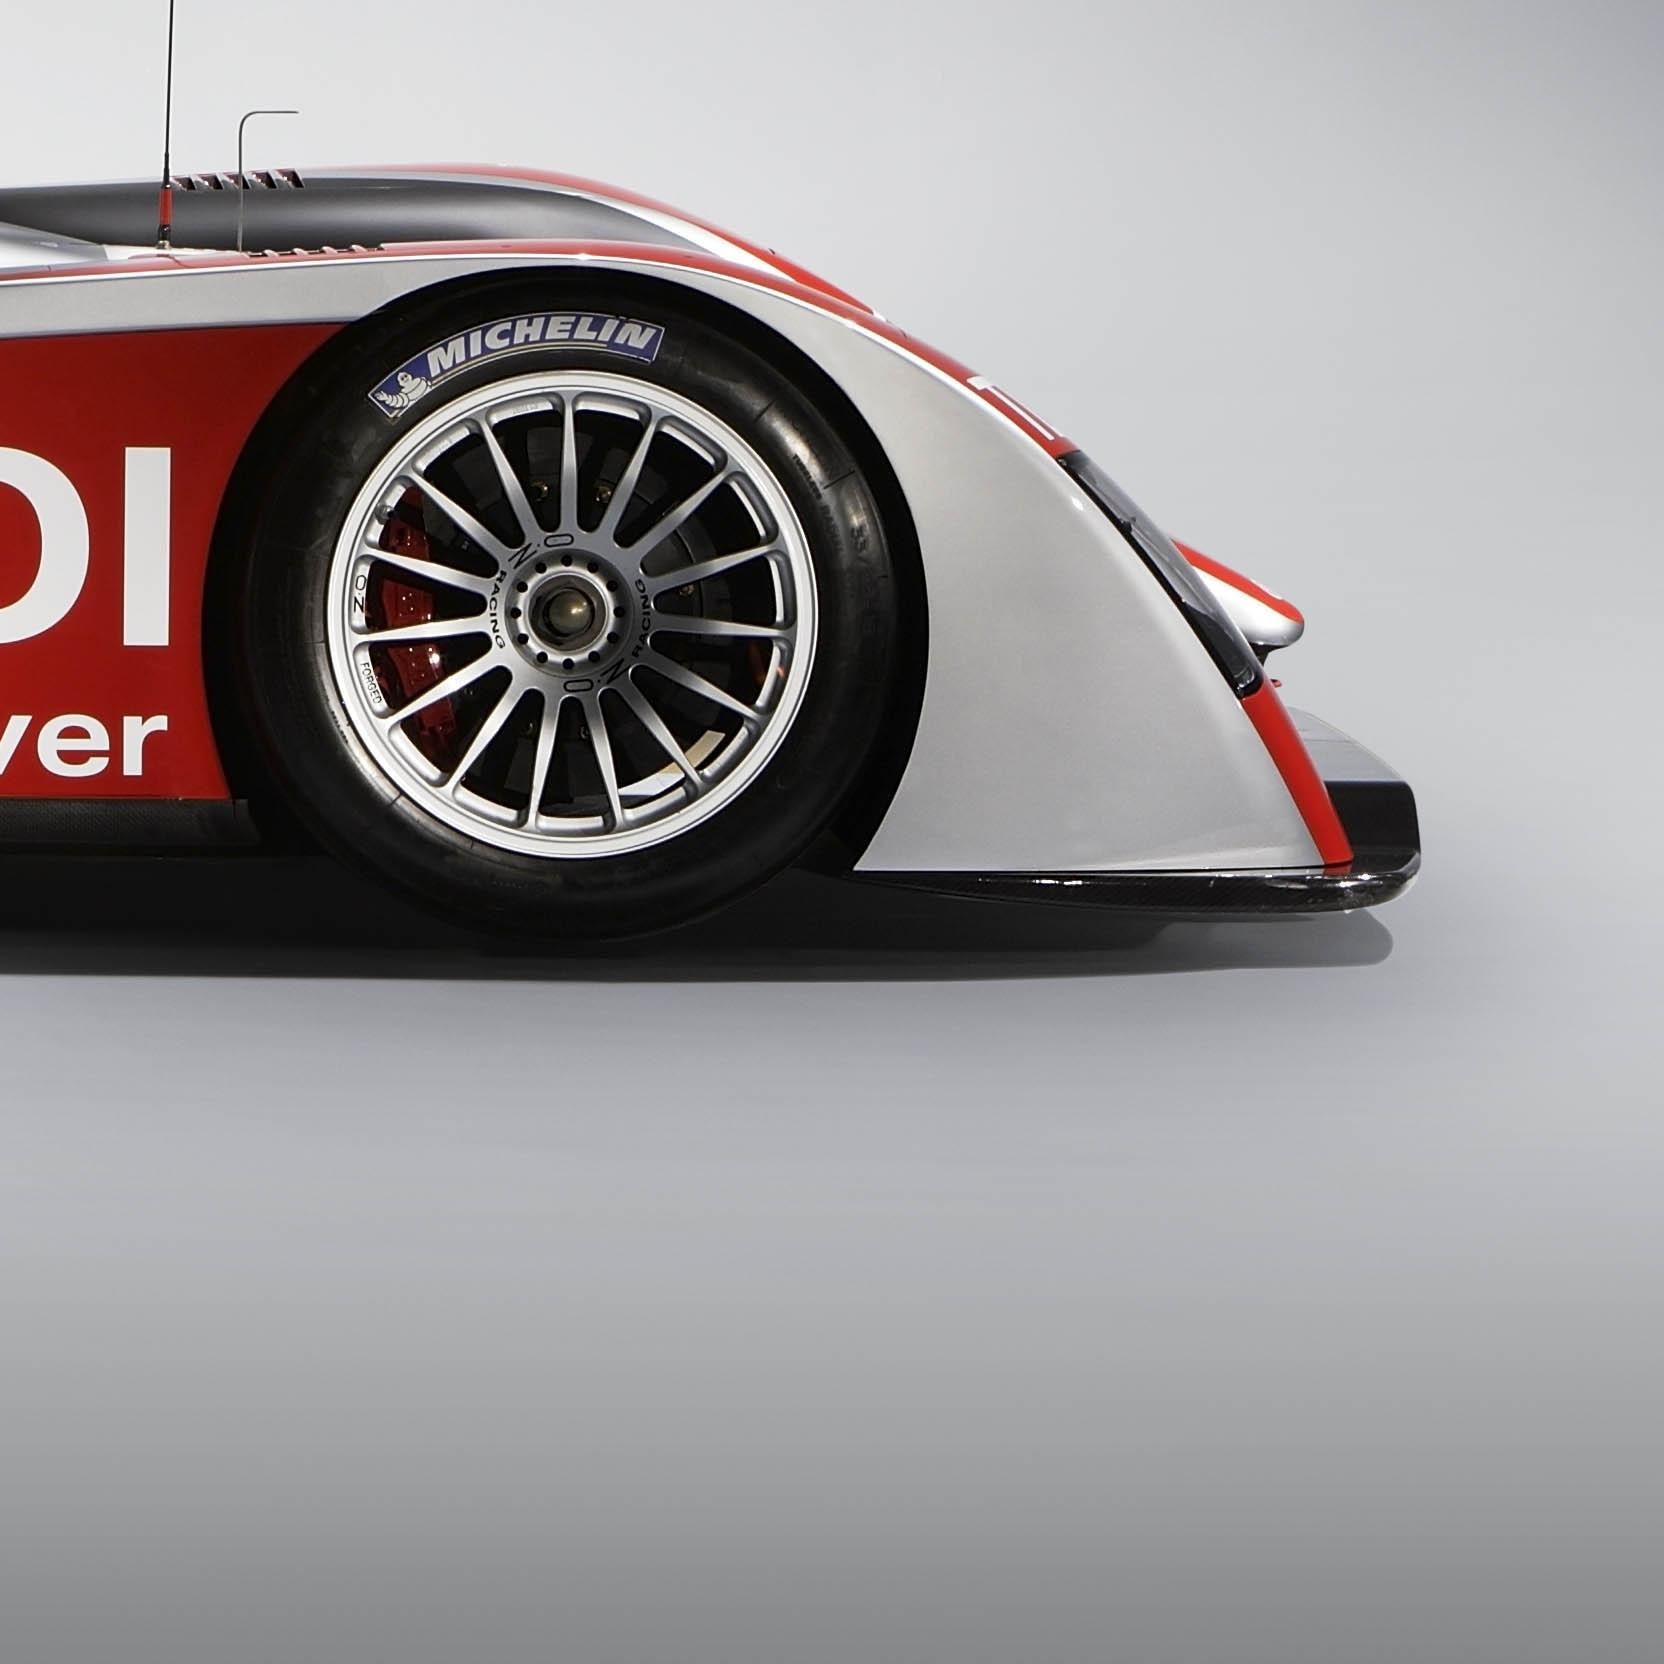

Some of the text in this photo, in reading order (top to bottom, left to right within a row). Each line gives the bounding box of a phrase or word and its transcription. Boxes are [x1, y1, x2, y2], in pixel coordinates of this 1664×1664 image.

[425, 315, 657, 378] MICHELIN
[488, 569, 508, 650] RACING
[631, 578, 653, 659] RACING
